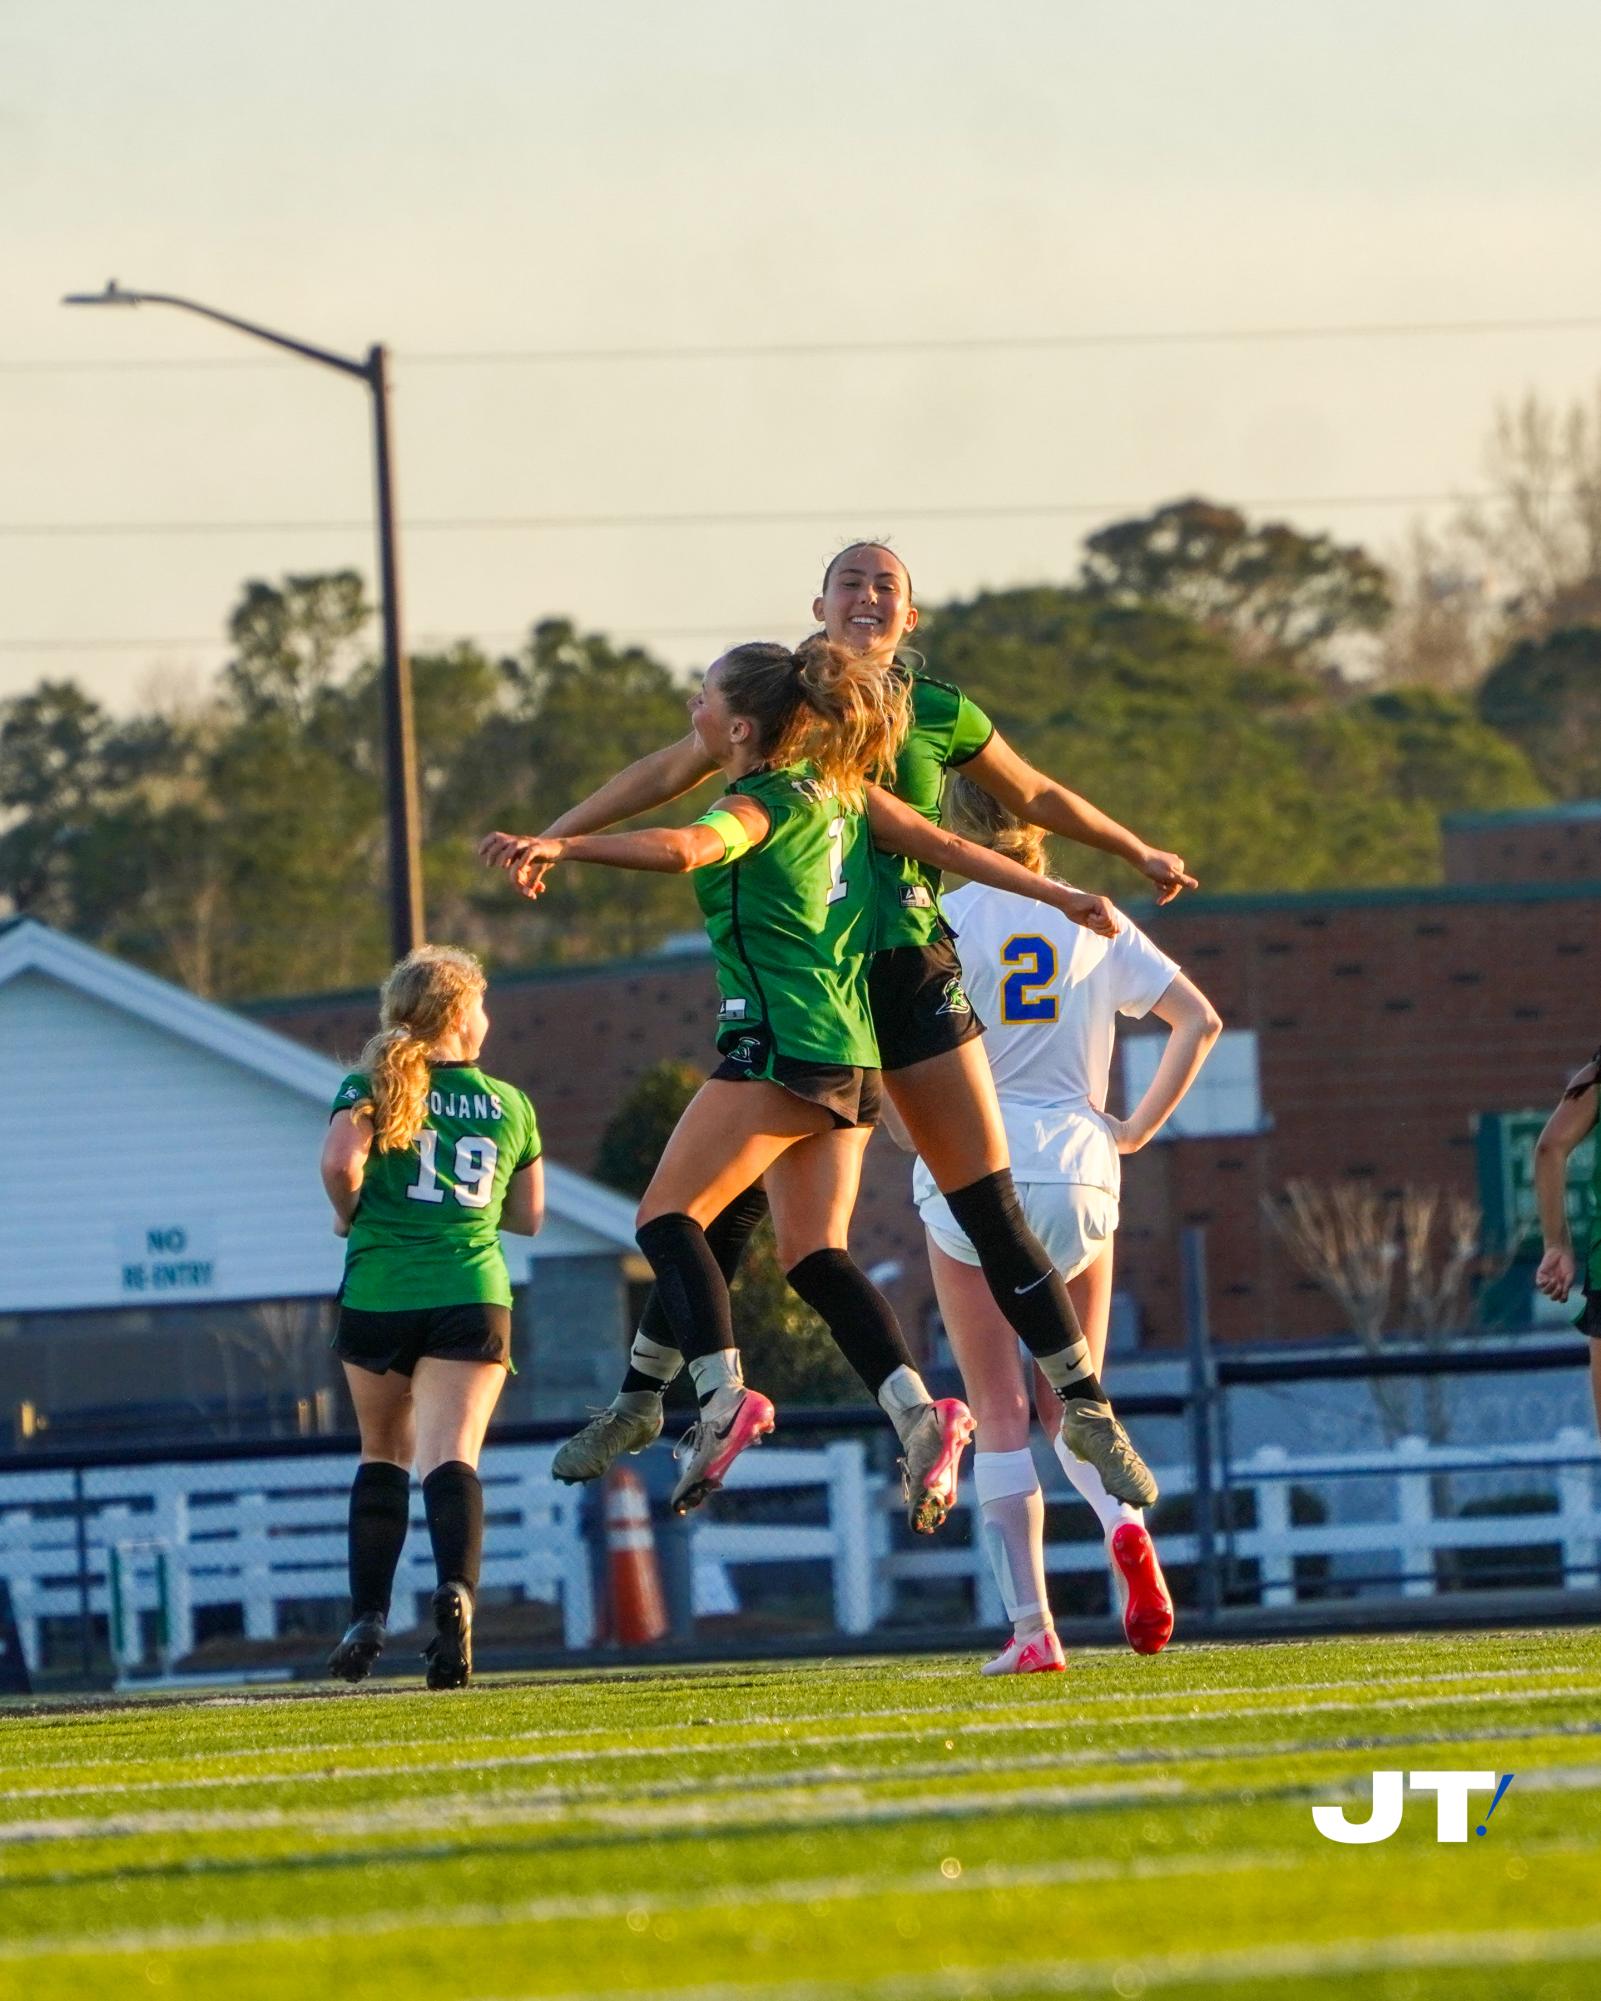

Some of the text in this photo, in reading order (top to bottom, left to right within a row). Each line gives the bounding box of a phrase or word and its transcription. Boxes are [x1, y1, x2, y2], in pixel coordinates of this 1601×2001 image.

[826, 817, 848, 906] 1
[1001, 933, 1060, 1025] 2
[425, 1090, 504, 1121] OJANS
[406, 1128, 498, 1208] 19
[146, 1228, 188, 1254] NO
